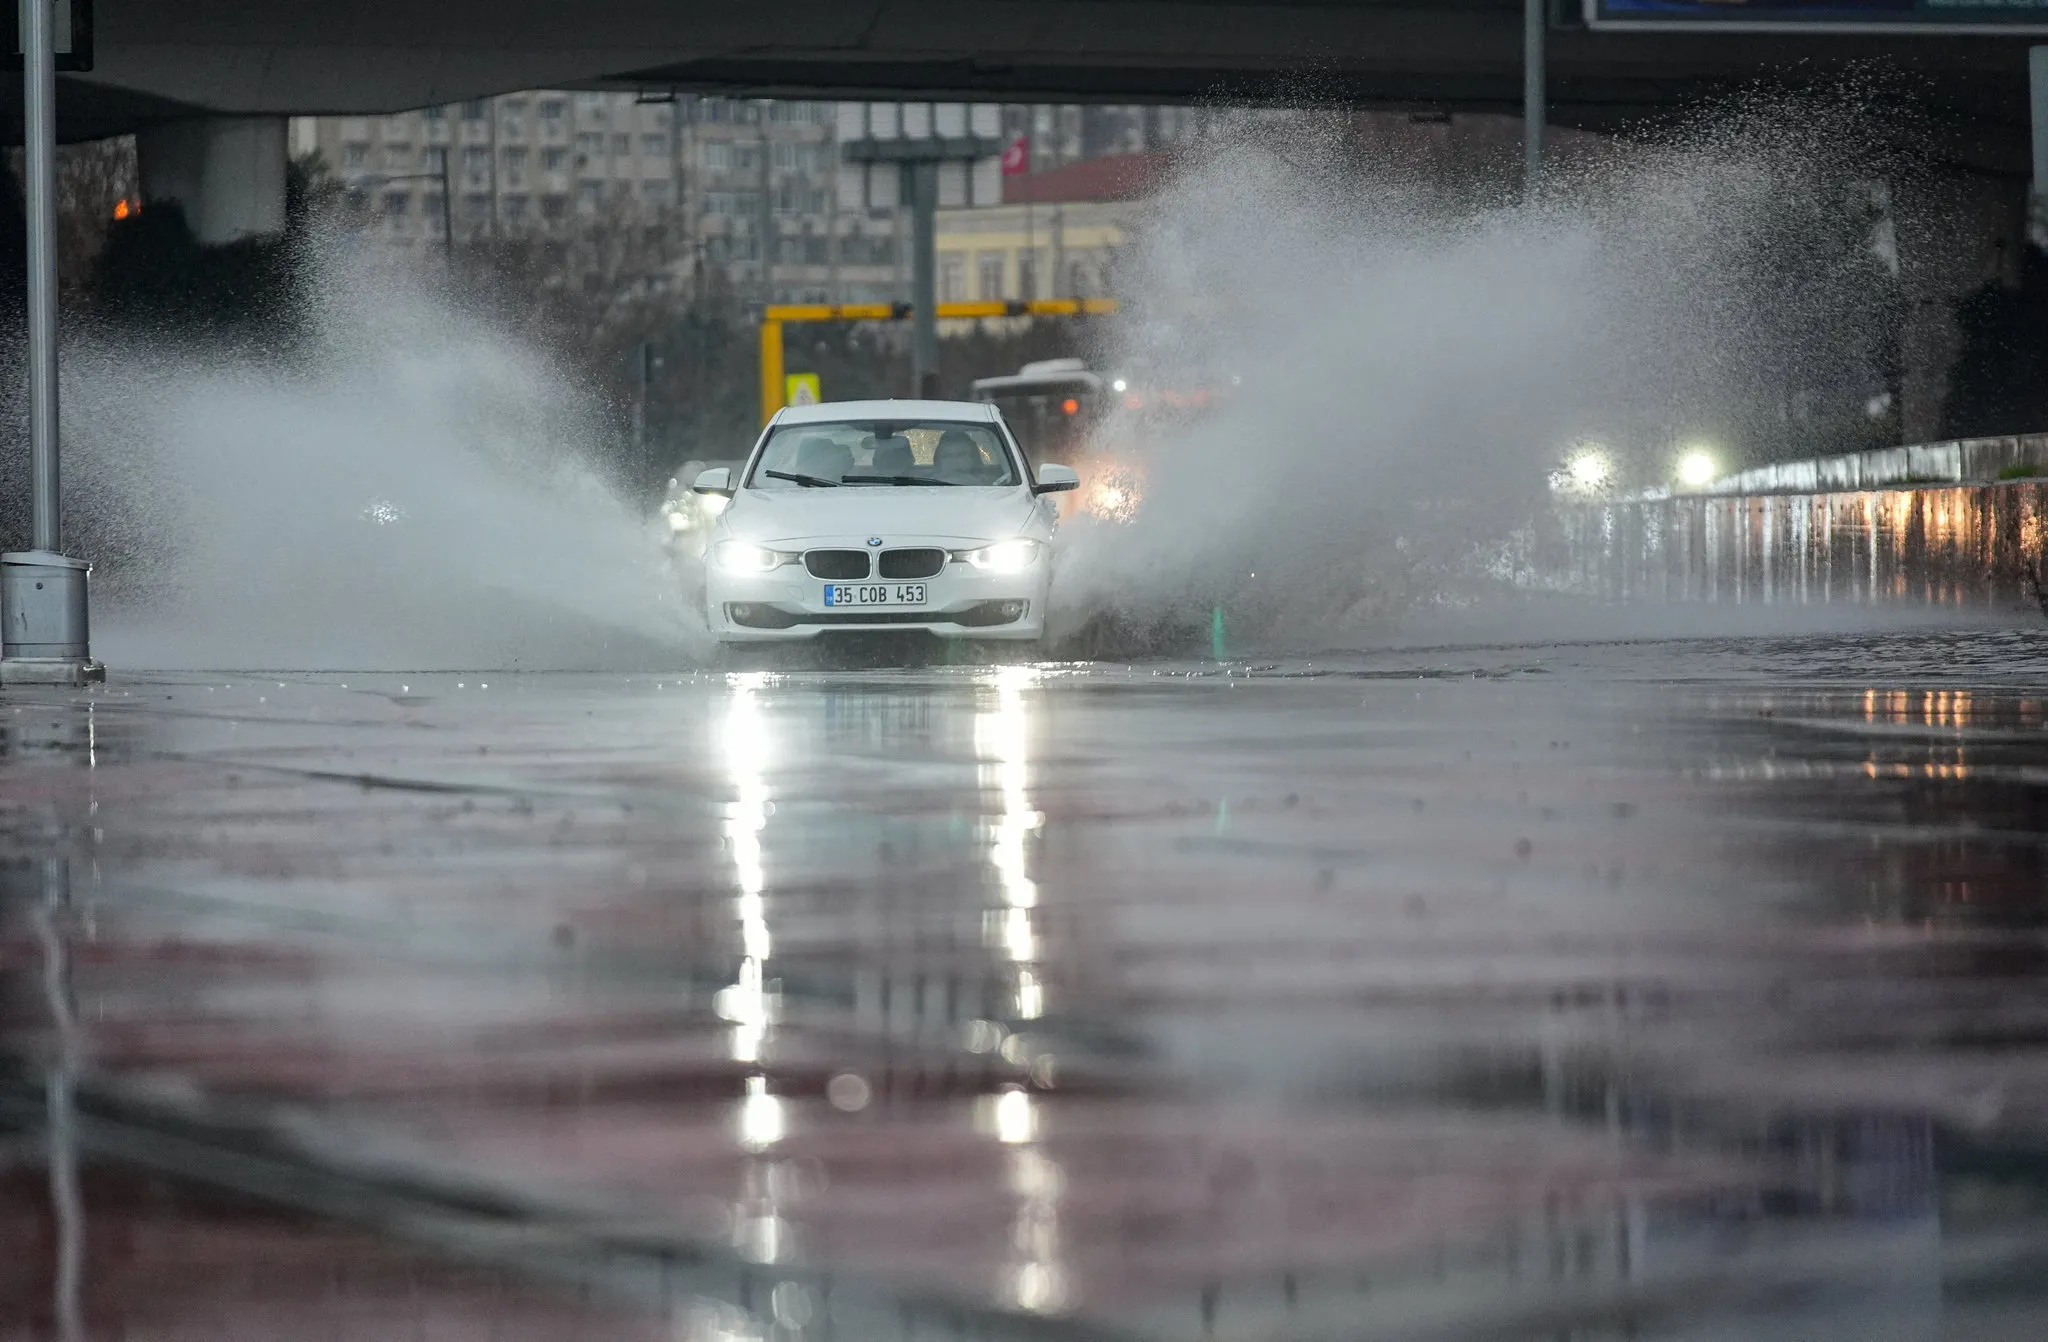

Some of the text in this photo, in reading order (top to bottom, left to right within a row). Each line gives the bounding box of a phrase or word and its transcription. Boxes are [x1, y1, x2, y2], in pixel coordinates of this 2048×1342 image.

[834, 587, 852, 603] 35
[860, 586, 887, 603] COB
[896, 586, 924, 602] 453
